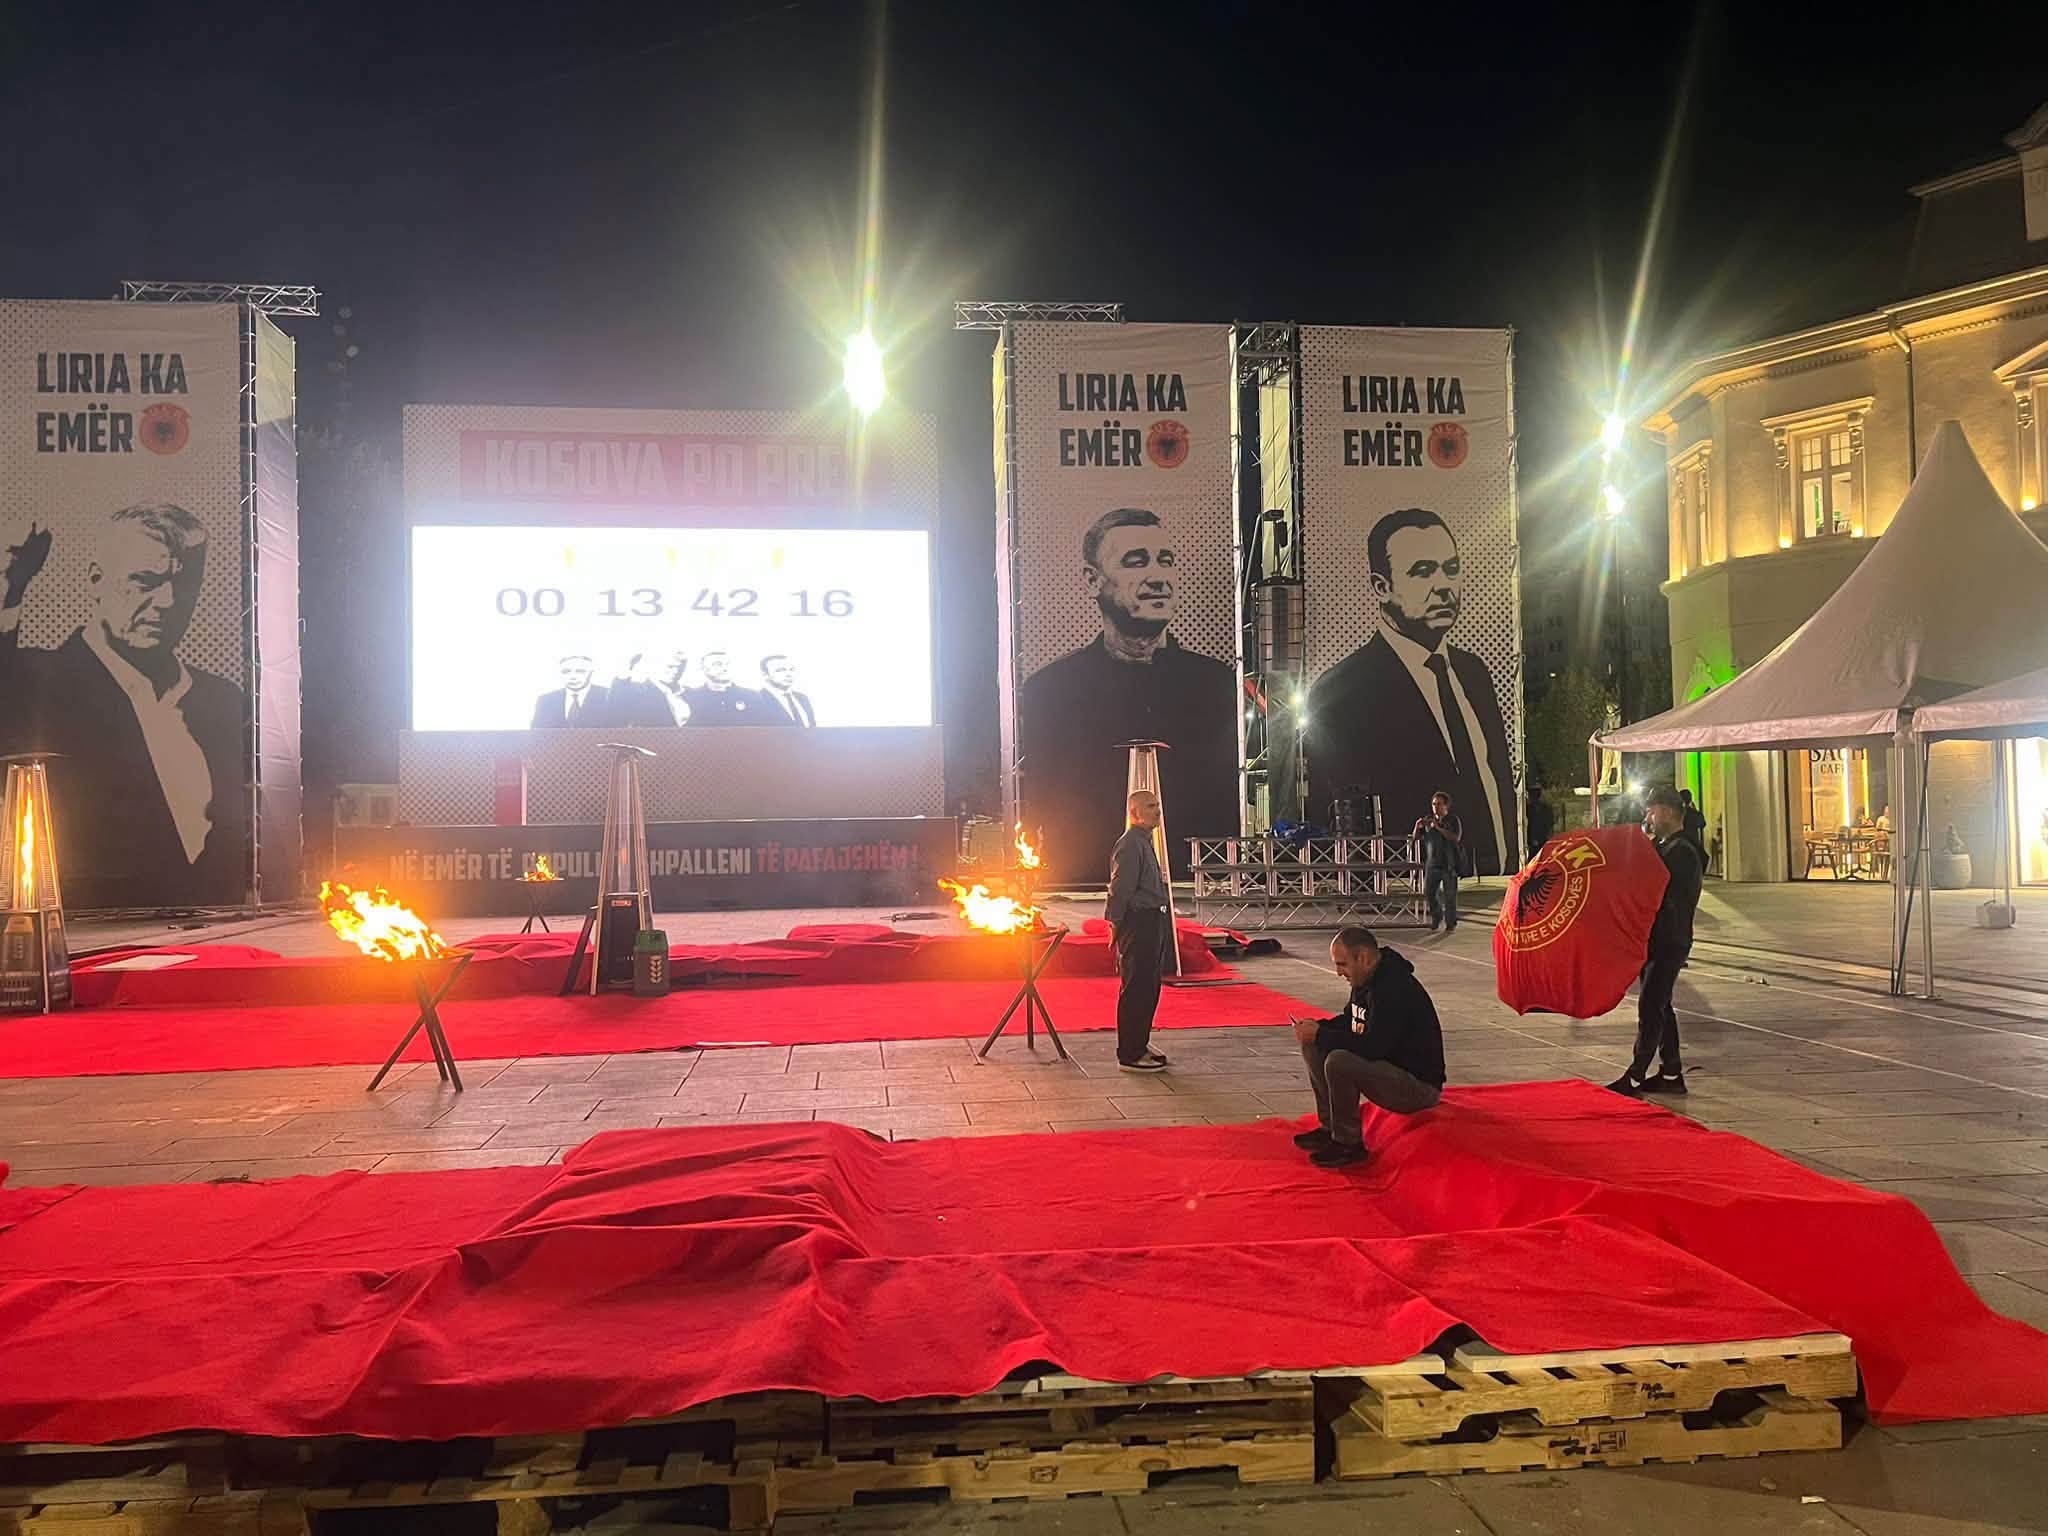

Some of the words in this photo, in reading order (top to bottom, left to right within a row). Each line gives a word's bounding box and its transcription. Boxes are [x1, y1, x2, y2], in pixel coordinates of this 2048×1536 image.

[37, 352, 131, 394] LIRIA
[139, 353, 188, 394] KA
[1058, 373, 1139, 412] LIRIA
[1146, 374, 1188, 413] KA
[1342, 375, 1420, 414] LIRIA
[1427, 377, 1466, 414] KA
[37, 403, 133, 453] EMËR
[1059, 420, 1143, 468] EMËR
[1343, 421, 1423, 468] EMËR
[484, 439, 668, 498] KOSOVA
[682, 442, 744, 498] PO
[495, 587, 567, 618] 00
[597, 587, 665, 618] 13
[690, 587, 760, 618] 42
[789, 587, 855, 618] 16
[389, 848, 419, 881] NË
[423, 848, 481, 881] EMËR
[487, 847, 512, 880] TË
[640, 848, 751, 877] HPALLENI
[757, 840, 782, 873] TË
